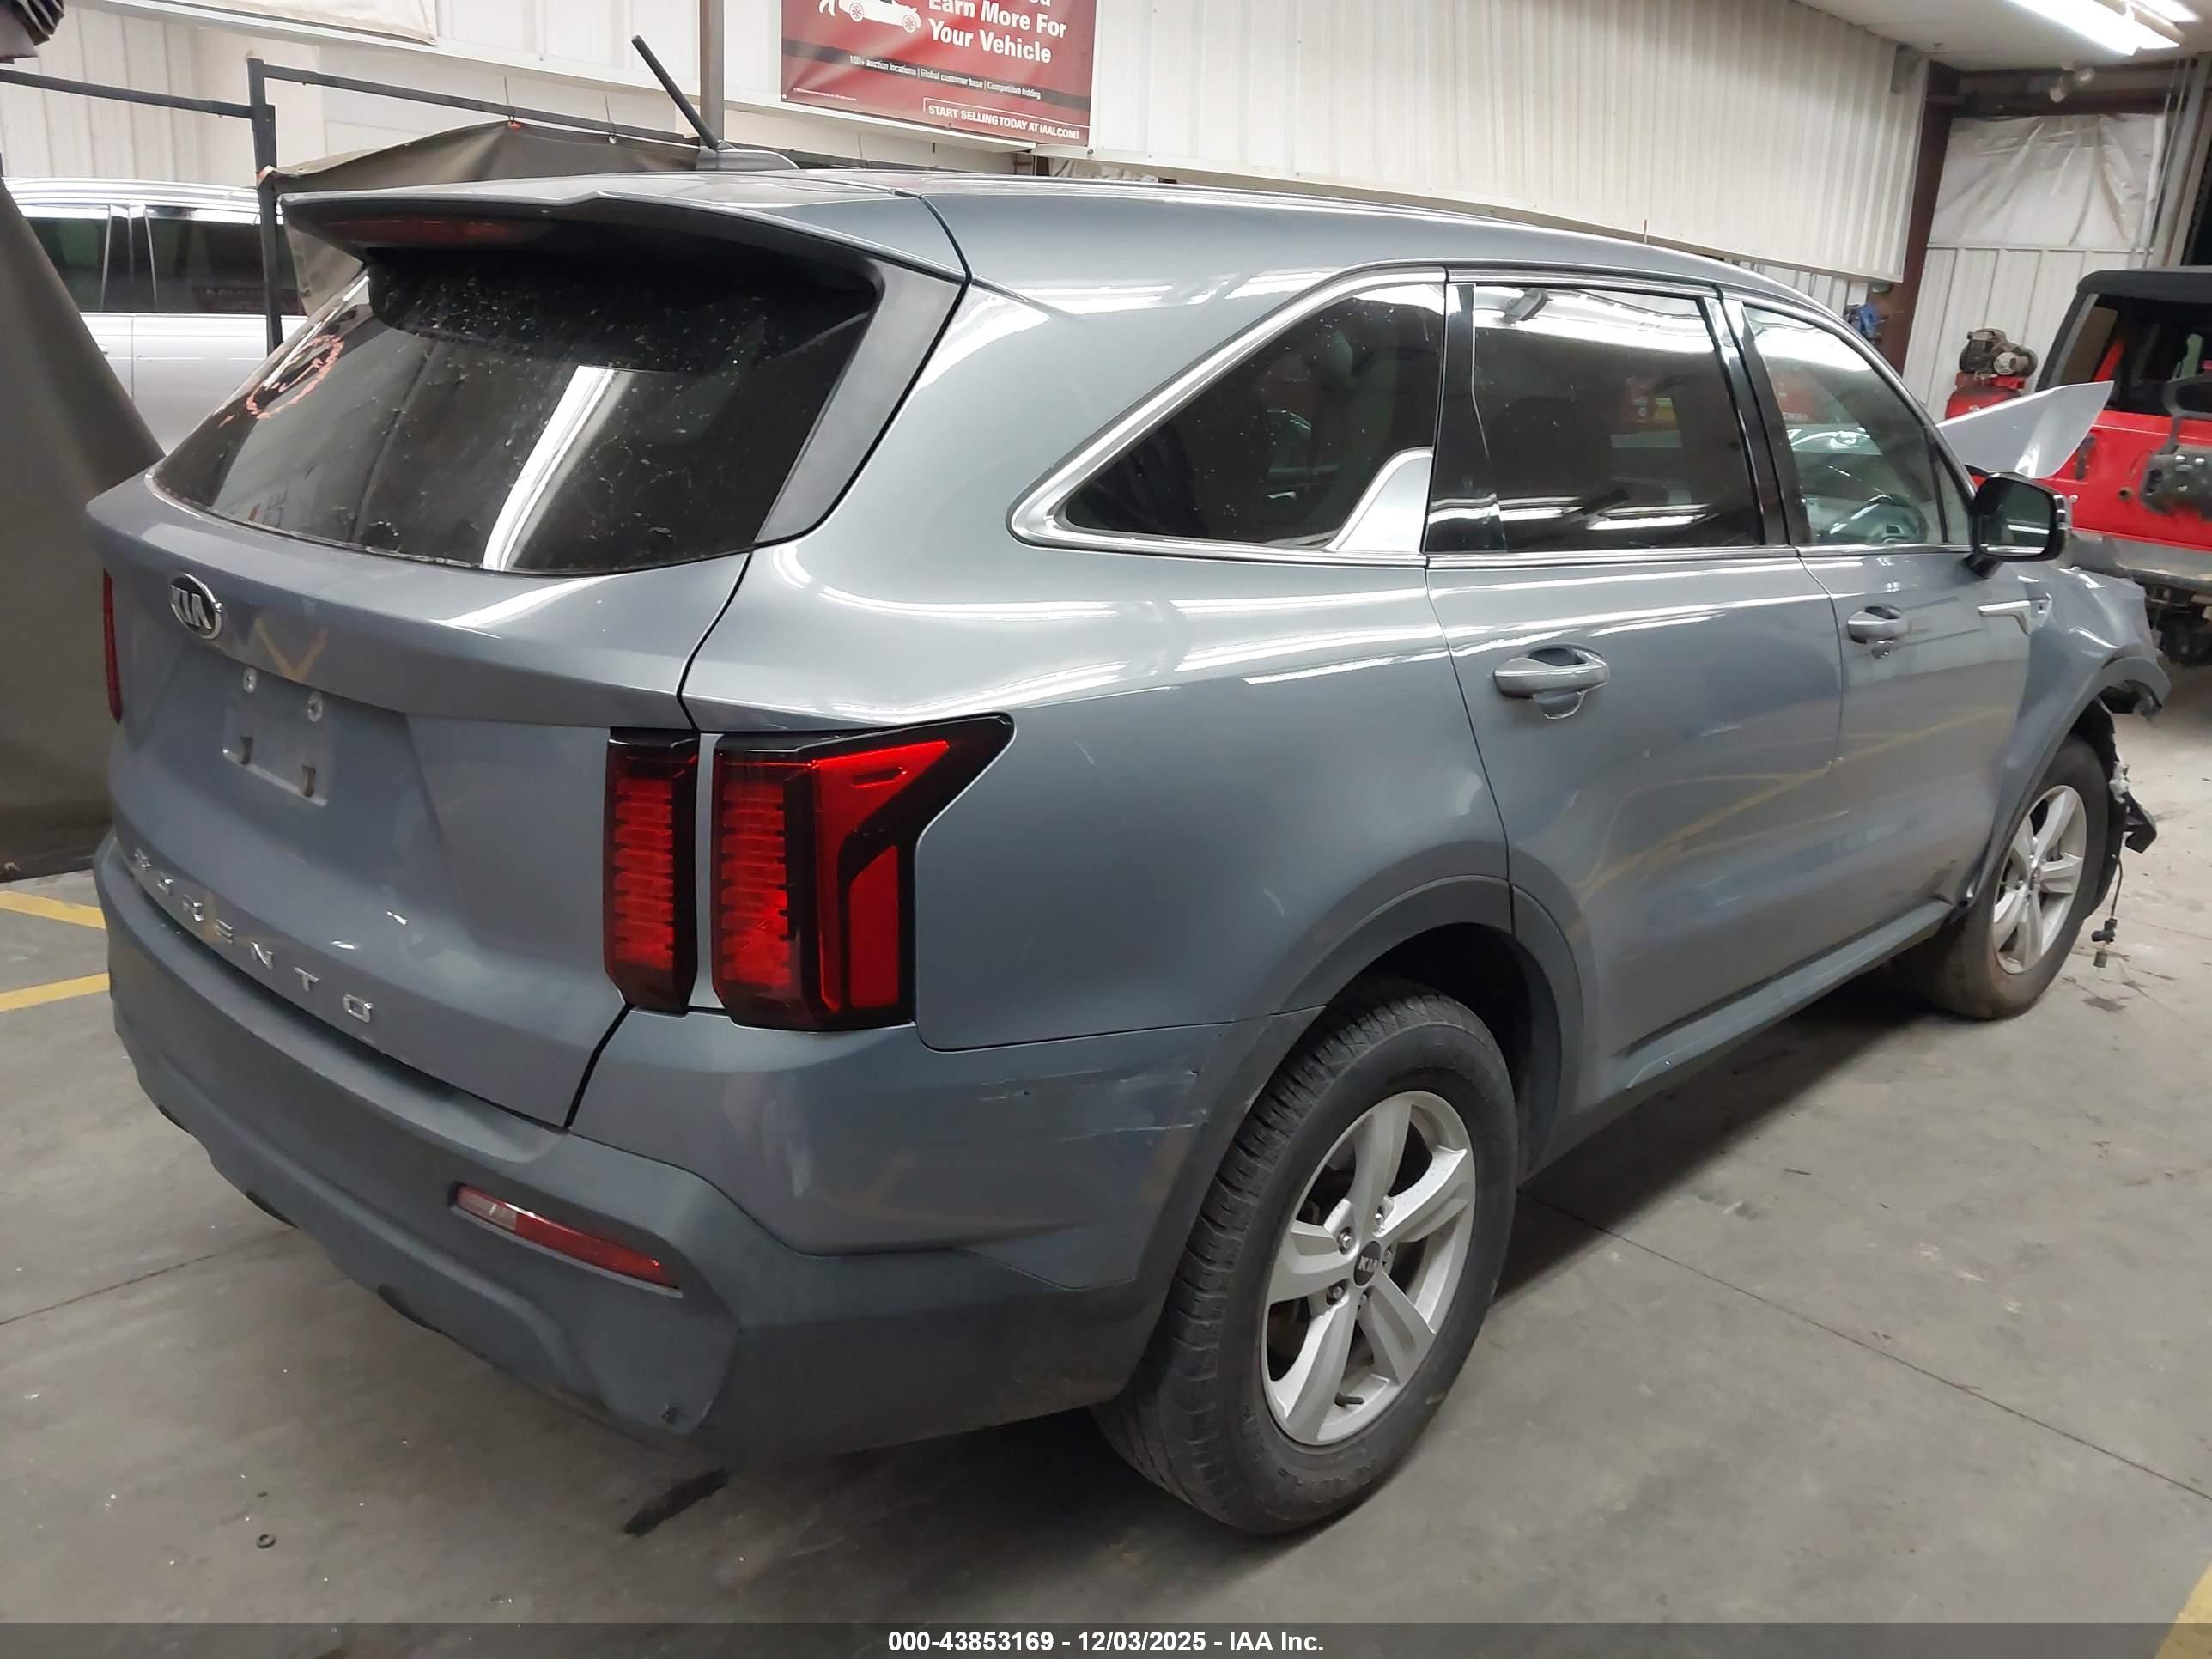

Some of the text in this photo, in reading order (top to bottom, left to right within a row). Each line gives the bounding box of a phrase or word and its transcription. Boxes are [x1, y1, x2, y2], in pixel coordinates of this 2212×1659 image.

[928, 0, 1067, 38] Earn More For
[928, 18, 1052, 63] Your Vehicle
[866, 59, 889, 70] auction
[889, 63, 916, 76] locations
[928, 105, 958, 118] START
[961, 110, 999, 125] SELLING
[999, 116, 1028, 130] TODAY
[1028, 123, 1039, 132] AT
[134, 848, 374, 1024] SORENTO
